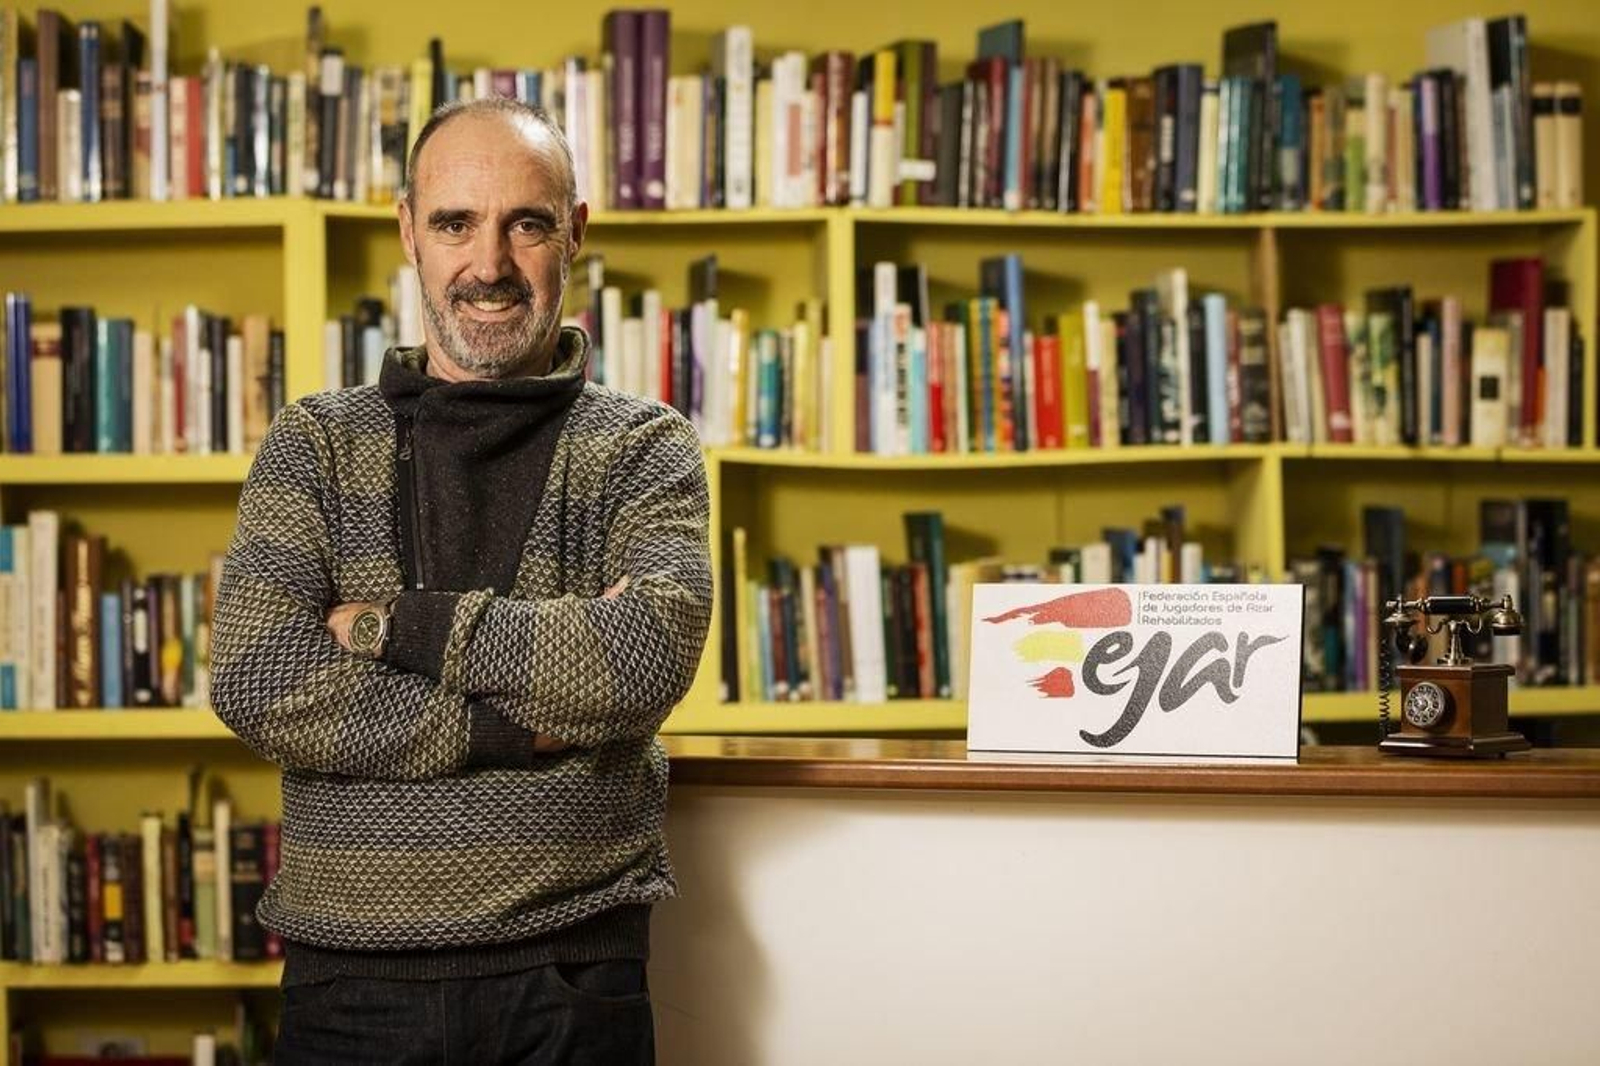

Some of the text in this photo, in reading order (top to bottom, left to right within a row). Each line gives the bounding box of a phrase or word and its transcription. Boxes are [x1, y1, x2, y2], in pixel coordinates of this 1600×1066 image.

[1143, 591, 1268, 602] Federación Española
[1142, 603, 1158, 612] de
[1161, 603, 1223, 614] Jugadores
[1227, 603, 1242, 612] de
[1142, 615, 1222, 625] Rehabilitados
